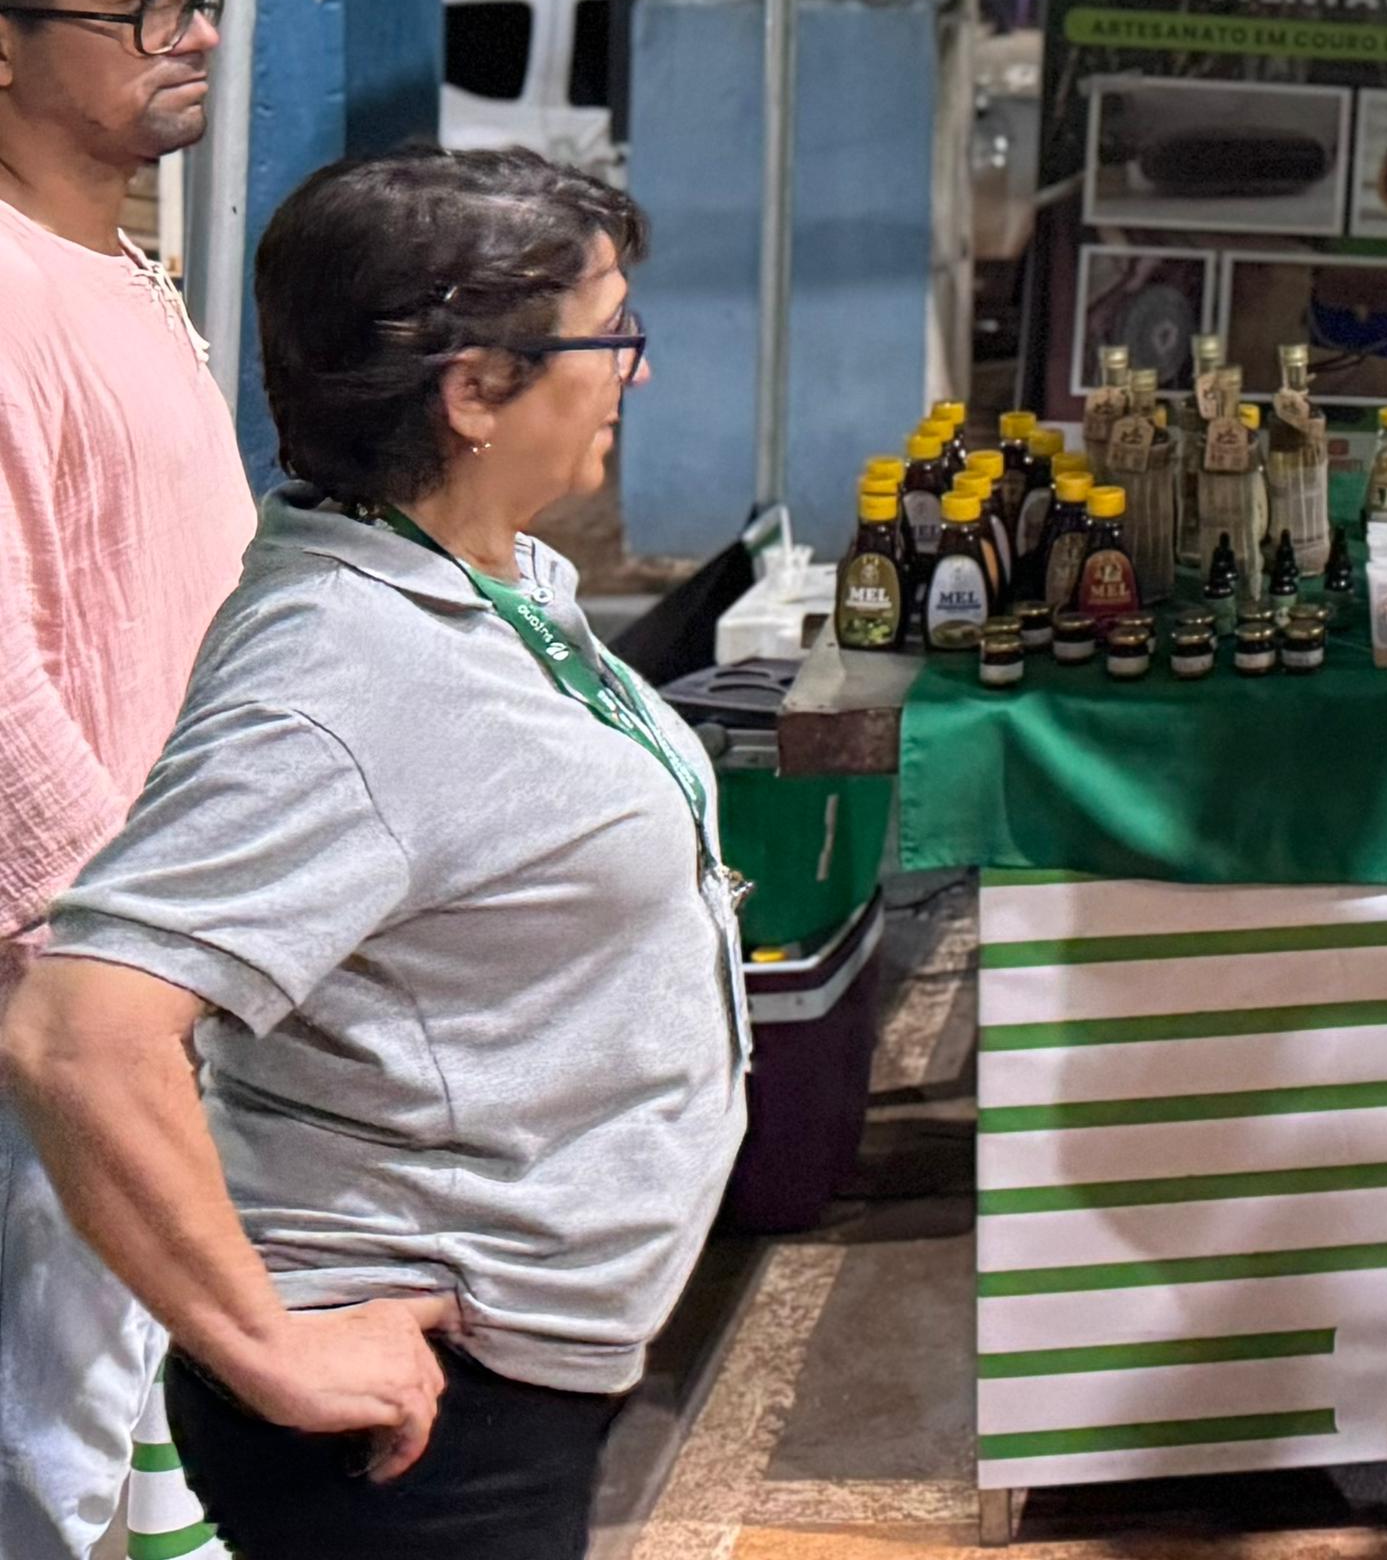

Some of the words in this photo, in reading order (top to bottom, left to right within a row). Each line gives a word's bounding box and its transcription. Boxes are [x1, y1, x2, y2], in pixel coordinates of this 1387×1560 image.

[1091, 19, 1247, 47] ARTESANATO
[1255, 28, 1288, 49] EM
[1294, 29, 1377, 52] COURO
[849, 585, 890, 603] MEL
[939, 590, 980, 604] MEL
[1090, 582, 1131, 598] MEL
